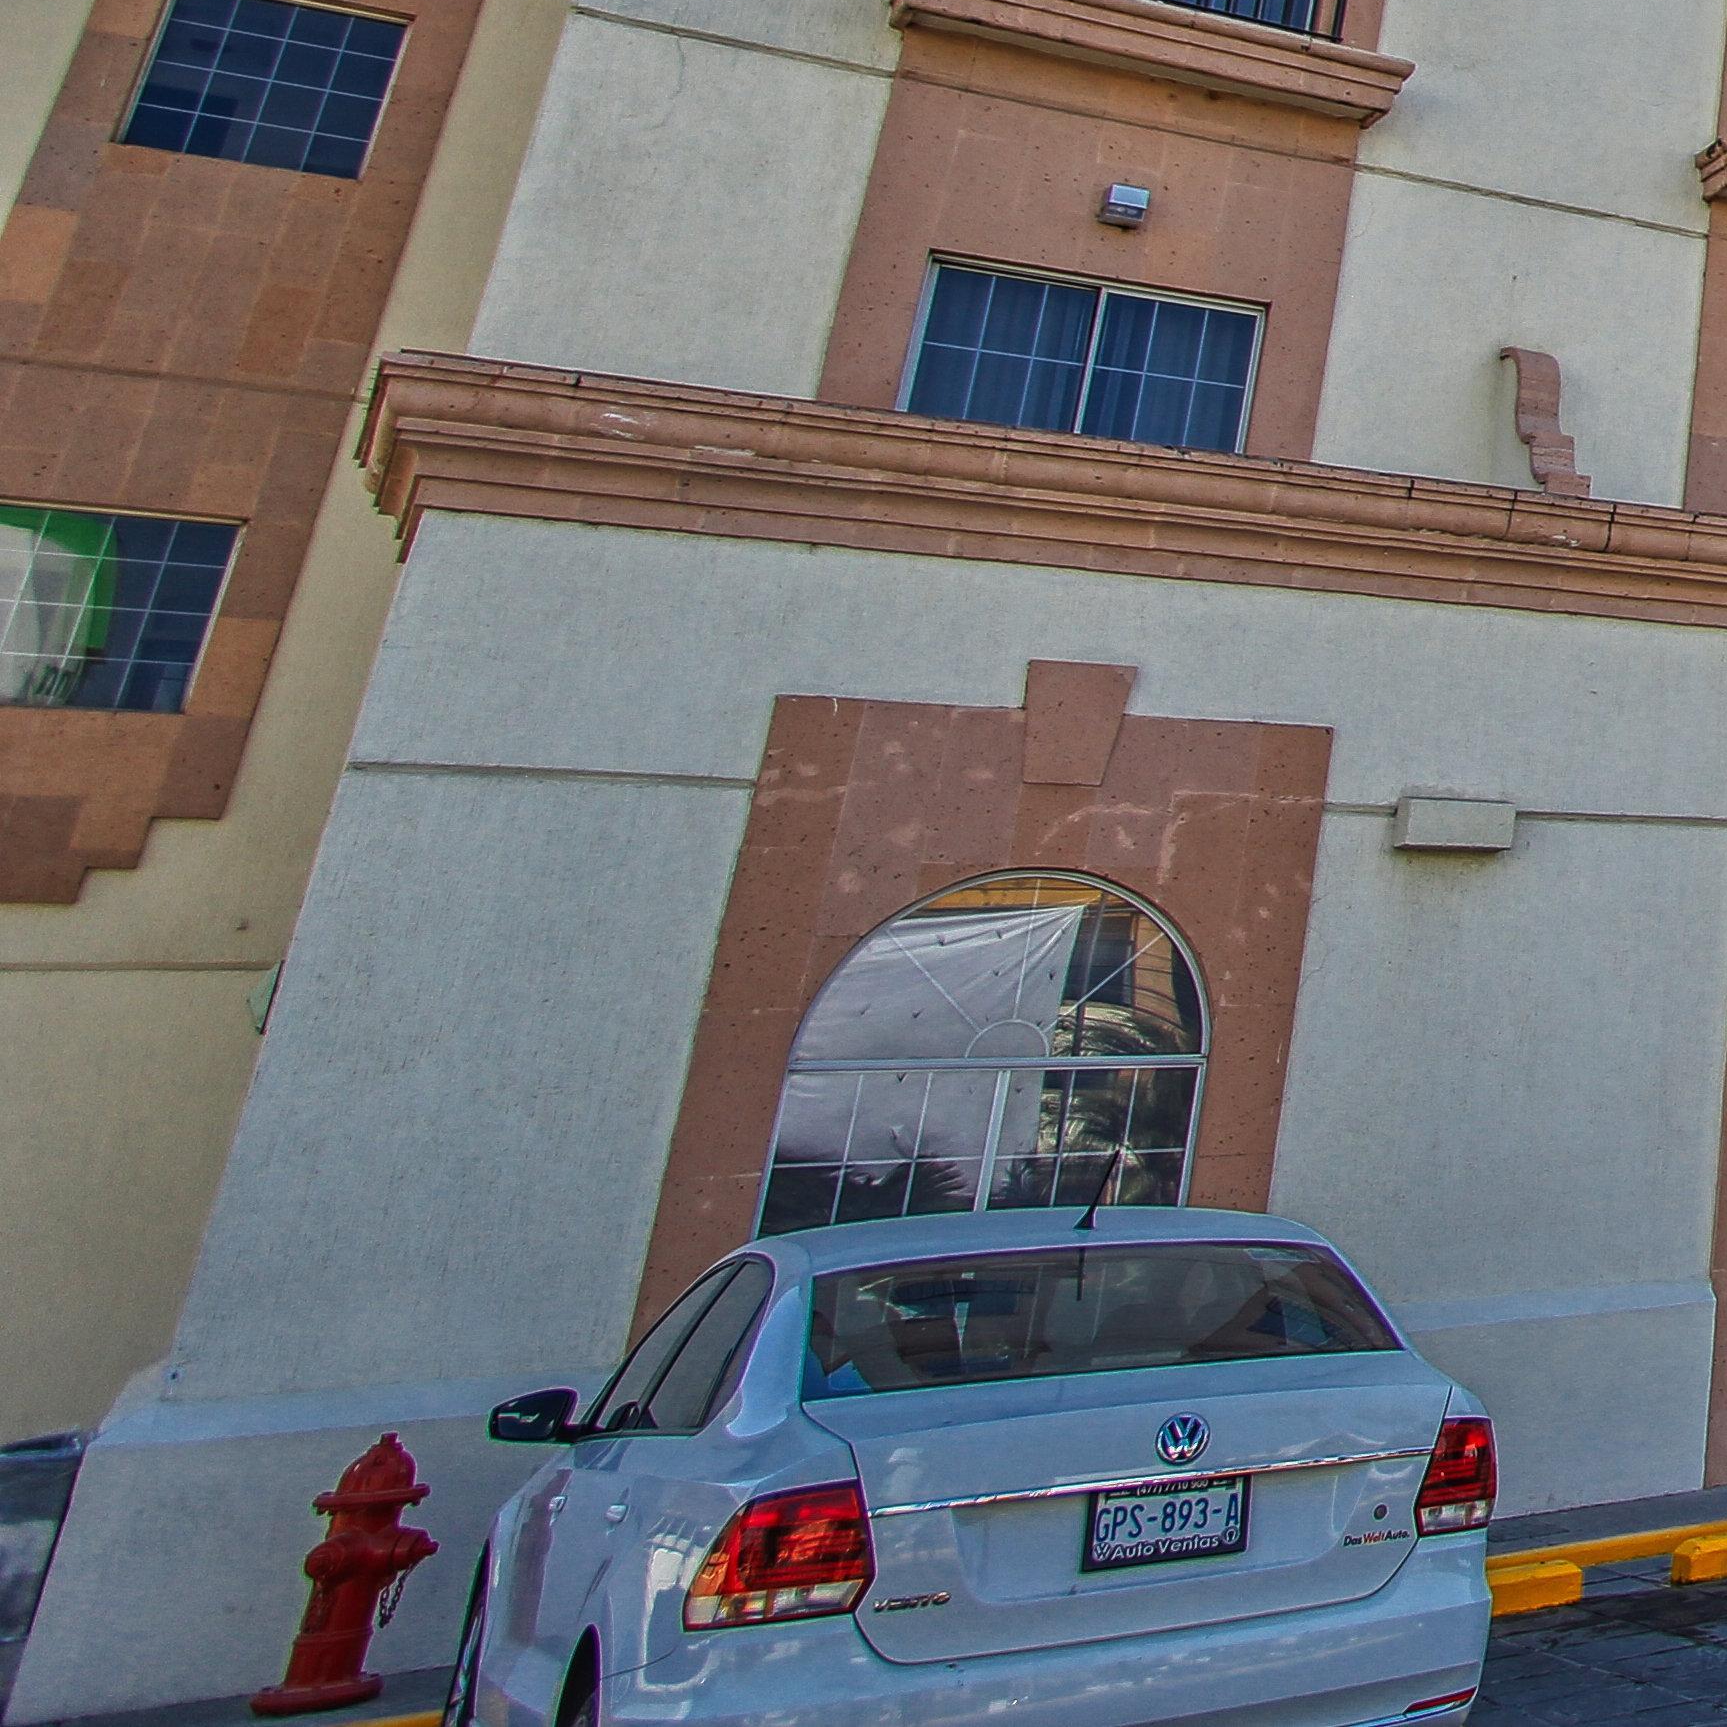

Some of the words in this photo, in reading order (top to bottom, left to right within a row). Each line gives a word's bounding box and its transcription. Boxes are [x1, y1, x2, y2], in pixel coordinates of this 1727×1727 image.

[1095, 1492, 1239, 1543] GPS-893-A
[1111, 1540, 1154, 1561] Auto
[1158, 1534, 1219, 1554] Ventas
